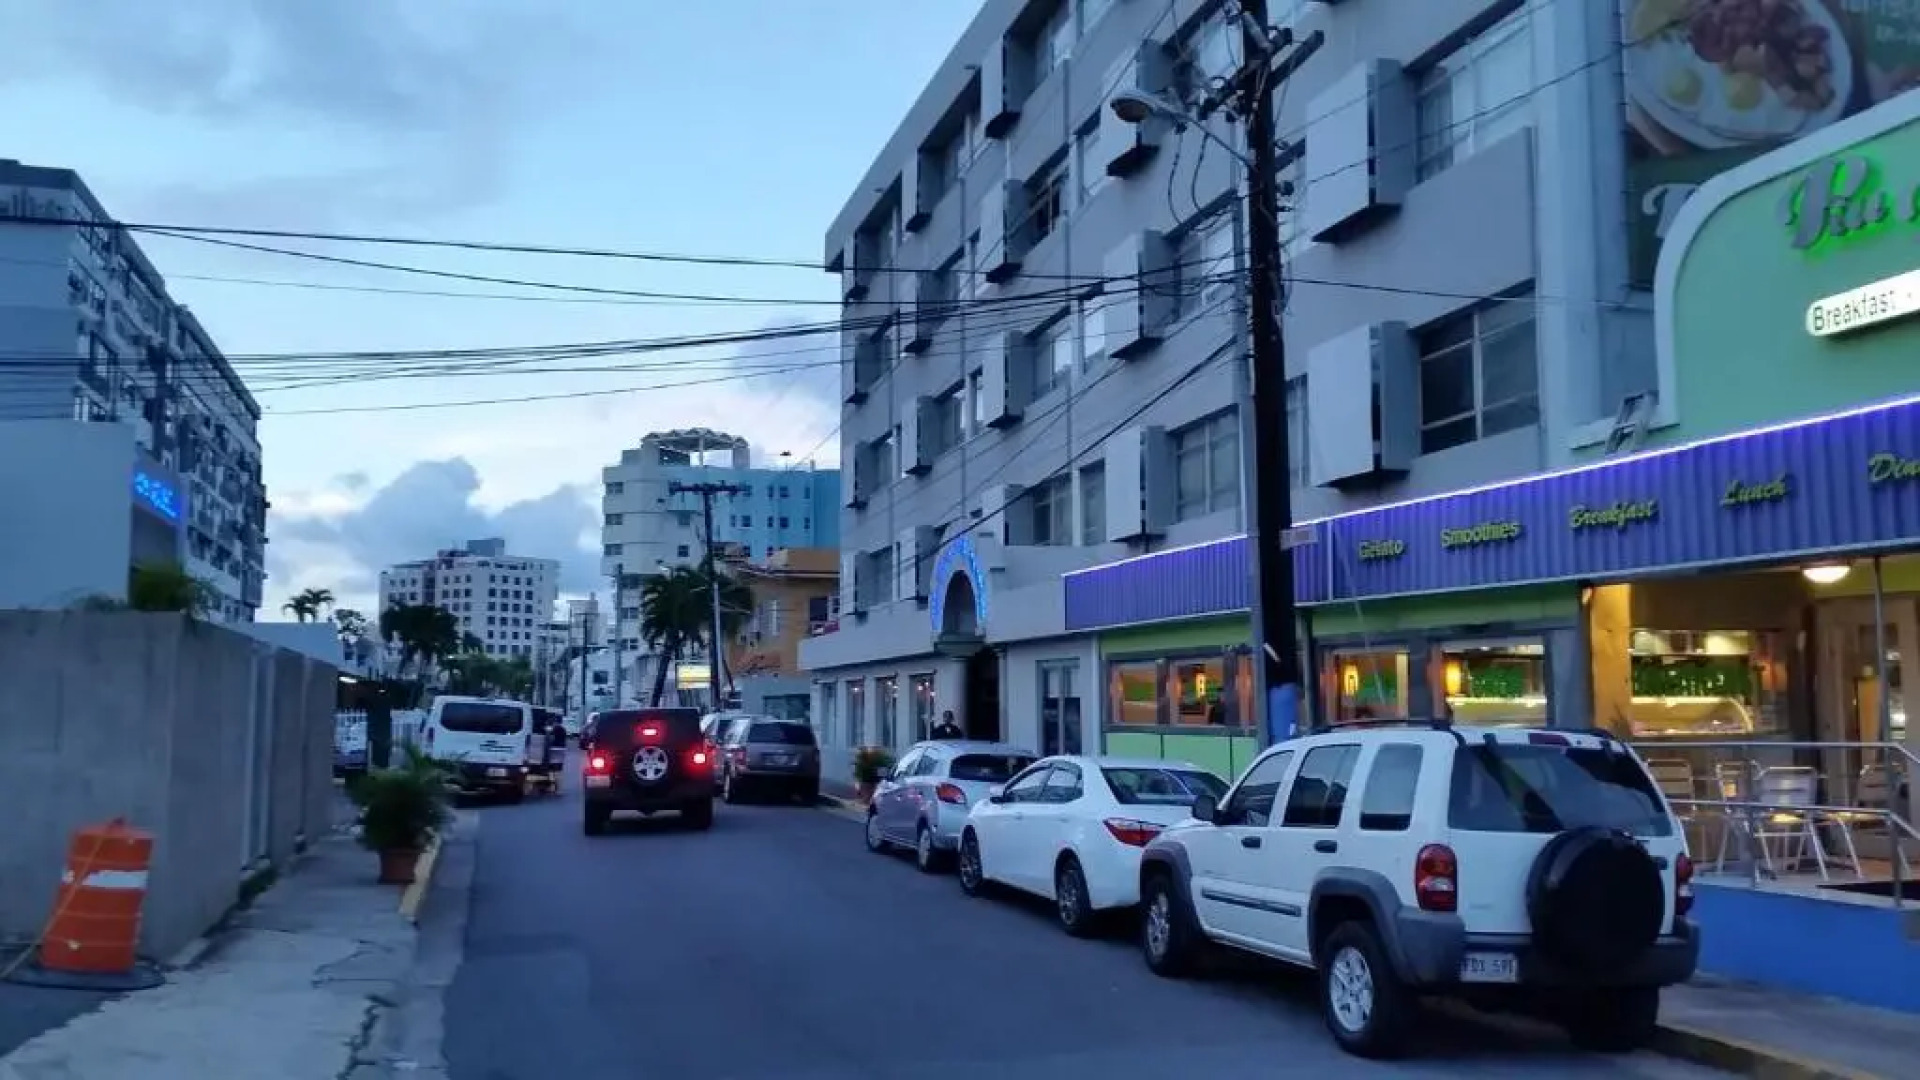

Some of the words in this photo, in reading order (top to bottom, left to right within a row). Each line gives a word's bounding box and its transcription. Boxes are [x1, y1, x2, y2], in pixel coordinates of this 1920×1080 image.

[1812, 290, 1895, 331] Breakfast
[1358, 539, 1404, 559] Gelato
[1440, 521, 1519, 548] Smoothies
[1570, 500, 1658, 528] Breakfast
[1720, 476, 1788, 507] Lunch
